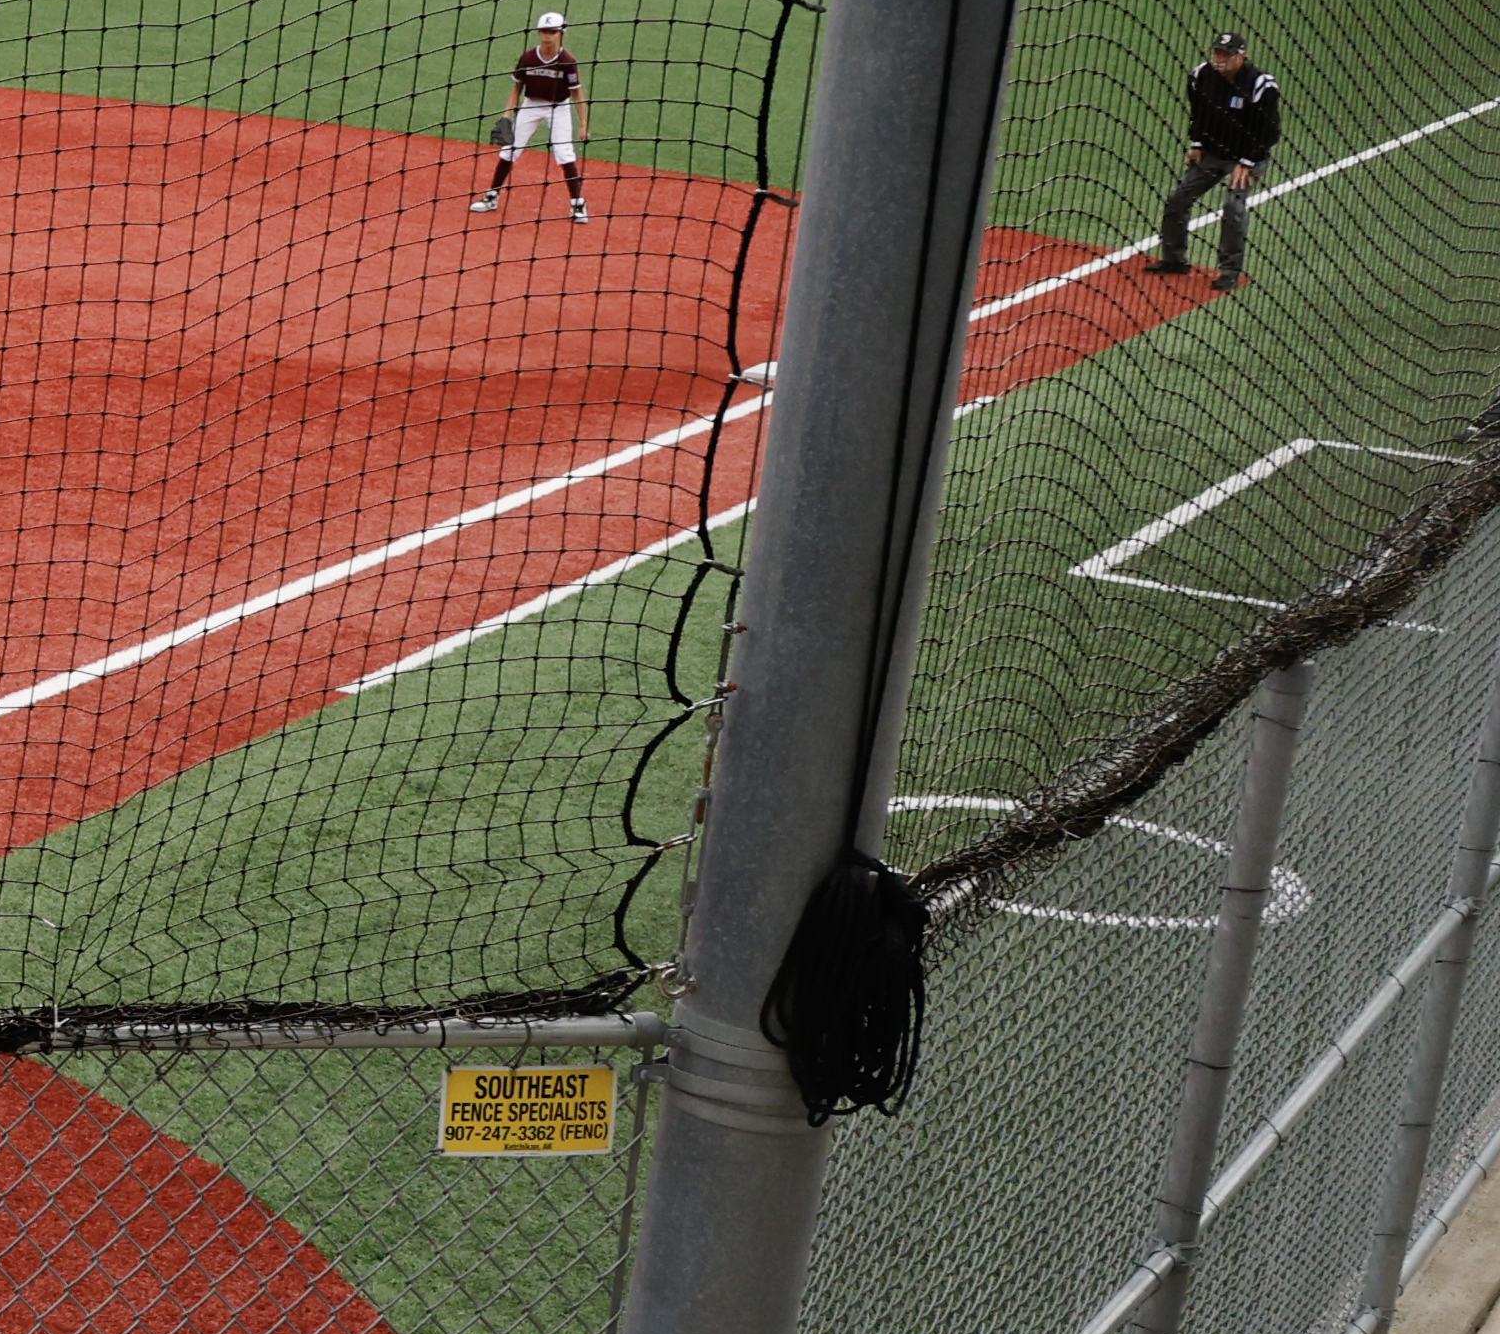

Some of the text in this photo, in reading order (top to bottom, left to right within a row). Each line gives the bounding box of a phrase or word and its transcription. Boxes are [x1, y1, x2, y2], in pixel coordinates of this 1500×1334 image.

[475, 1074, 589, 1099] SOUTHEAST
[451, 1101, 607, 1122] FENCE SPECIALISTS
[445, 1122, 608, 1141] 907-247-3362 (FENC)
